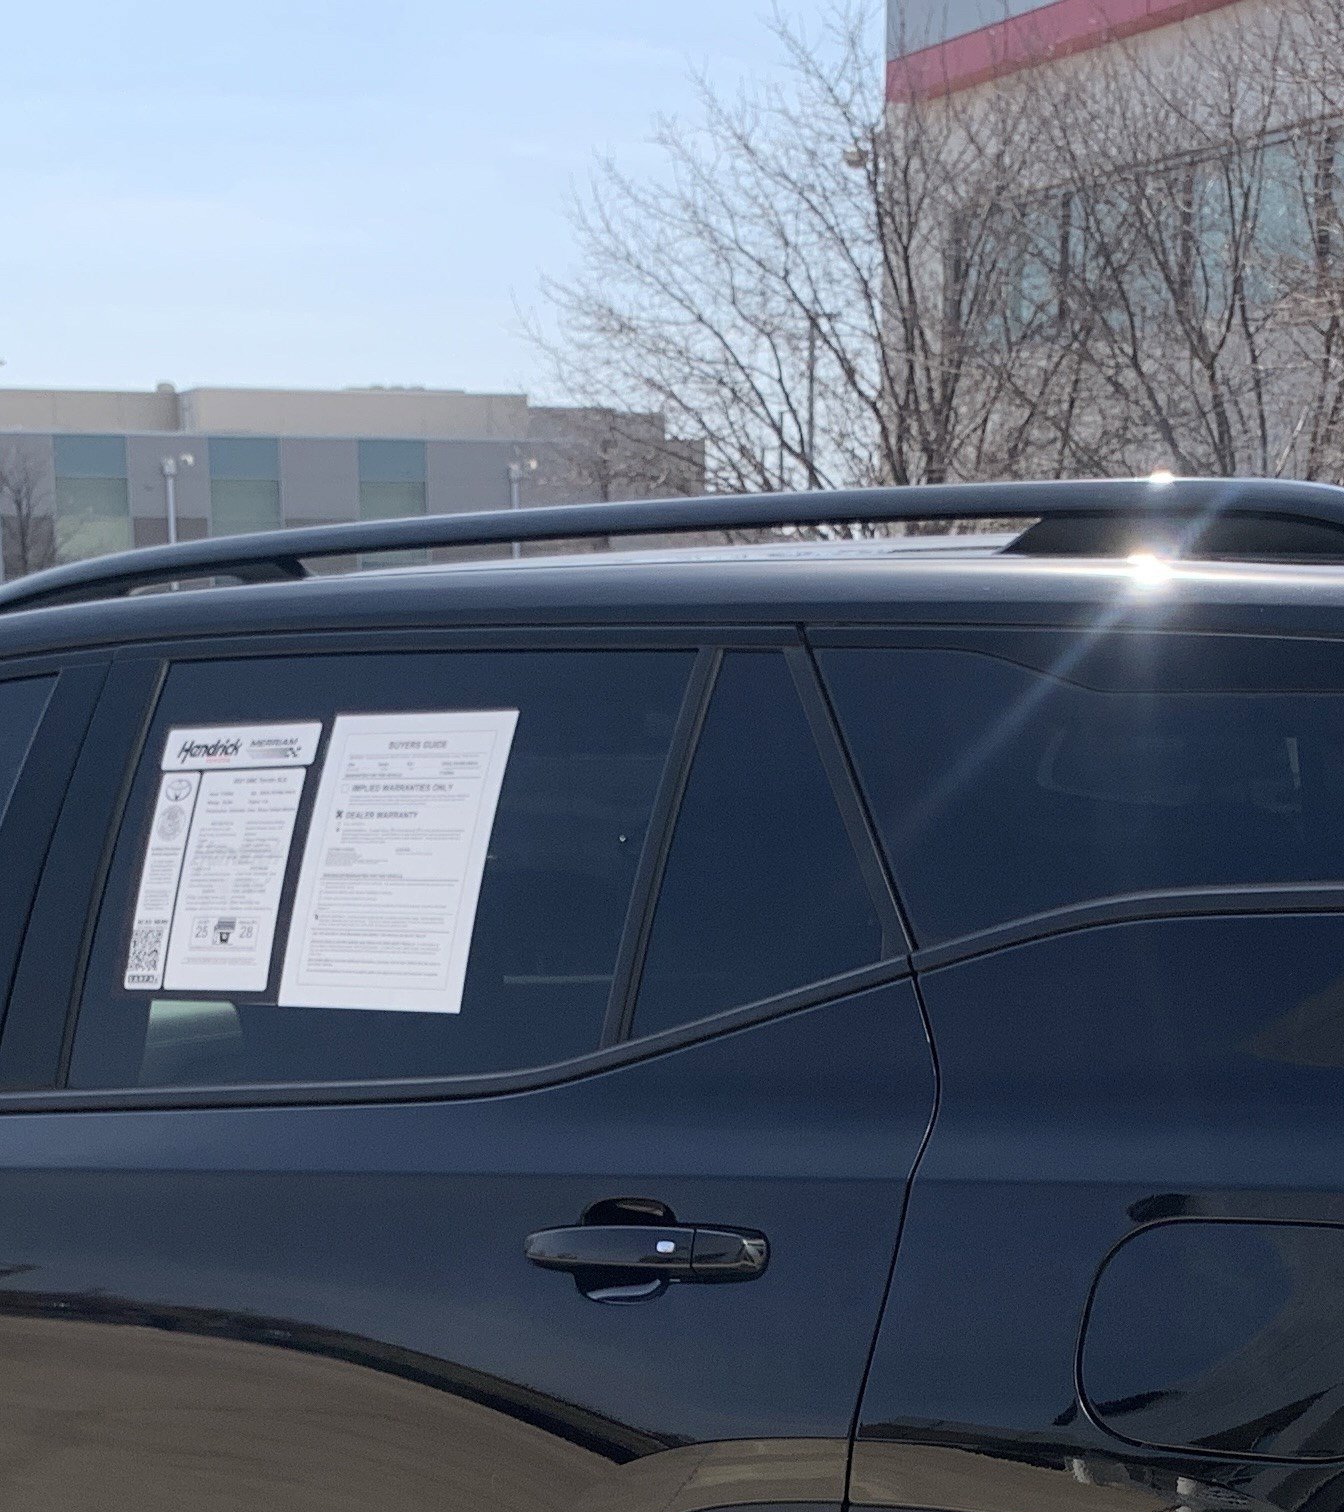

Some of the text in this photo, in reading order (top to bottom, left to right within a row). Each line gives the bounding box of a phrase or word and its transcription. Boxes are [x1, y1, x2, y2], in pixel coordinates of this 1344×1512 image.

[388, 740, 447, 749] BUYERS GUIDE
[177, 738, 242, 764] Hendrick
[195, 926, 208, 938] 25
